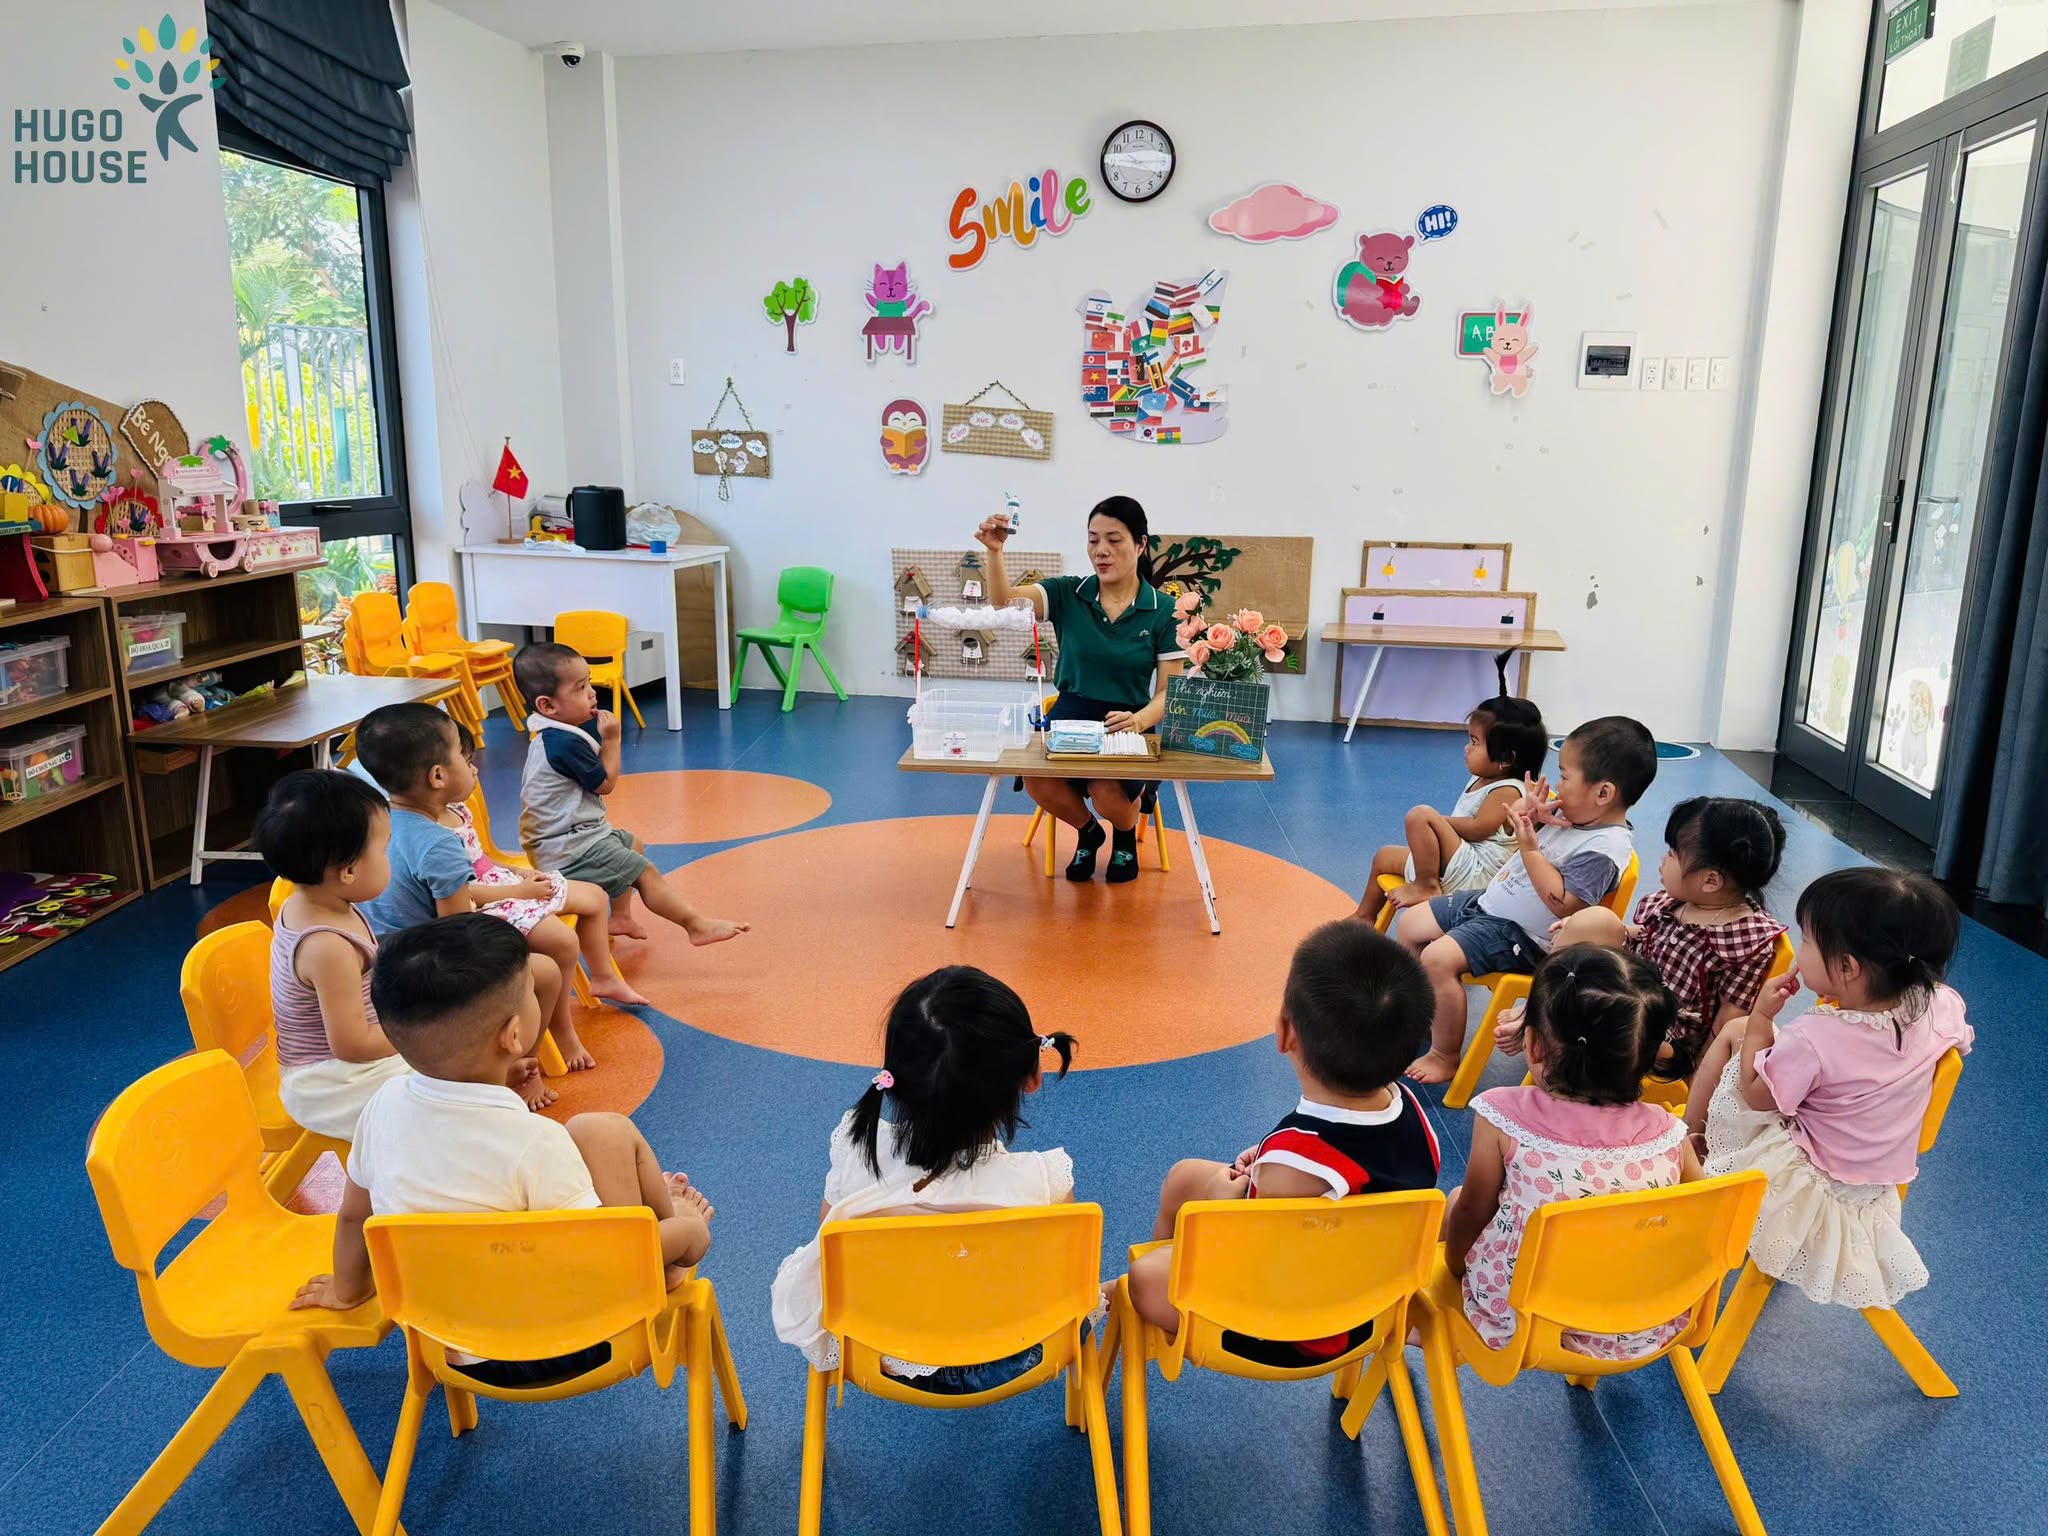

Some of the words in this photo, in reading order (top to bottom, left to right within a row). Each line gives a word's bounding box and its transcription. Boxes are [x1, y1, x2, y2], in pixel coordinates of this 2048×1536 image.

[1896, 5, 1921, 34] EXIT
[1901, 23, 1922, 46] THOÁT
[1122, 132, 1130, 143] 11
[1135, 129, 1144, 139] 12
[1113, 144, 1122, 153] 10
[1158, 142, 1164, 152] 2
[1113, 172, 1119, 181] 8
[1157, 171, 1162, 179] 4
[1122, 182, 1128, 191] 7
[1135, 185, 1141, 194] 6
[1148, 181, 1153, 190] 5
[949, 169, 1091, 269] Smile
[1424, 210, 1452, 232] HI!
[130, 404, 154, 436] Bé
[698, 442, 714, 450] Góc
